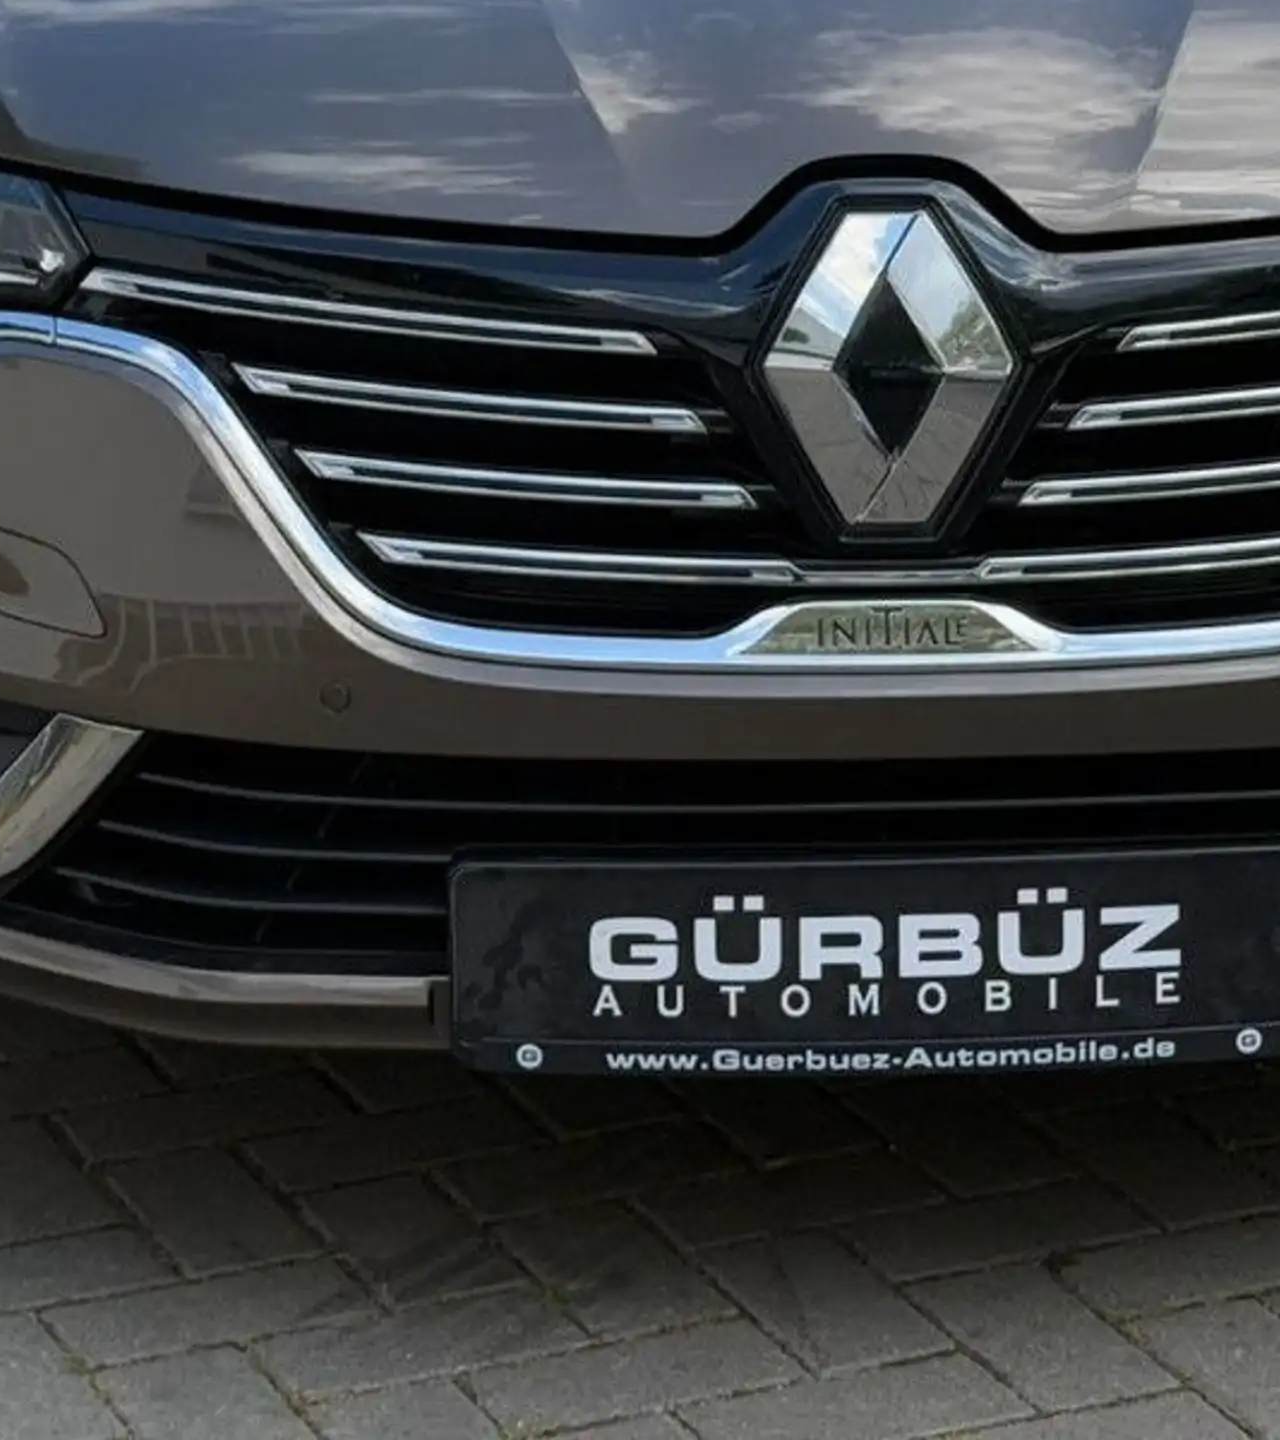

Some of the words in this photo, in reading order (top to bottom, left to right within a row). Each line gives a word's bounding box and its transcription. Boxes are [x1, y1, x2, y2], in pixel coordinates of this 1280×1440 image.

[818, 605, 971, 647] INITIALE
[588, 886, 1182, 981] GÜRBÜZ
[592, 971, 1182, 1018] AUTOMOBILE
[605, 1036, 1177, 1073] www.Guerbuez-Automobile.de
